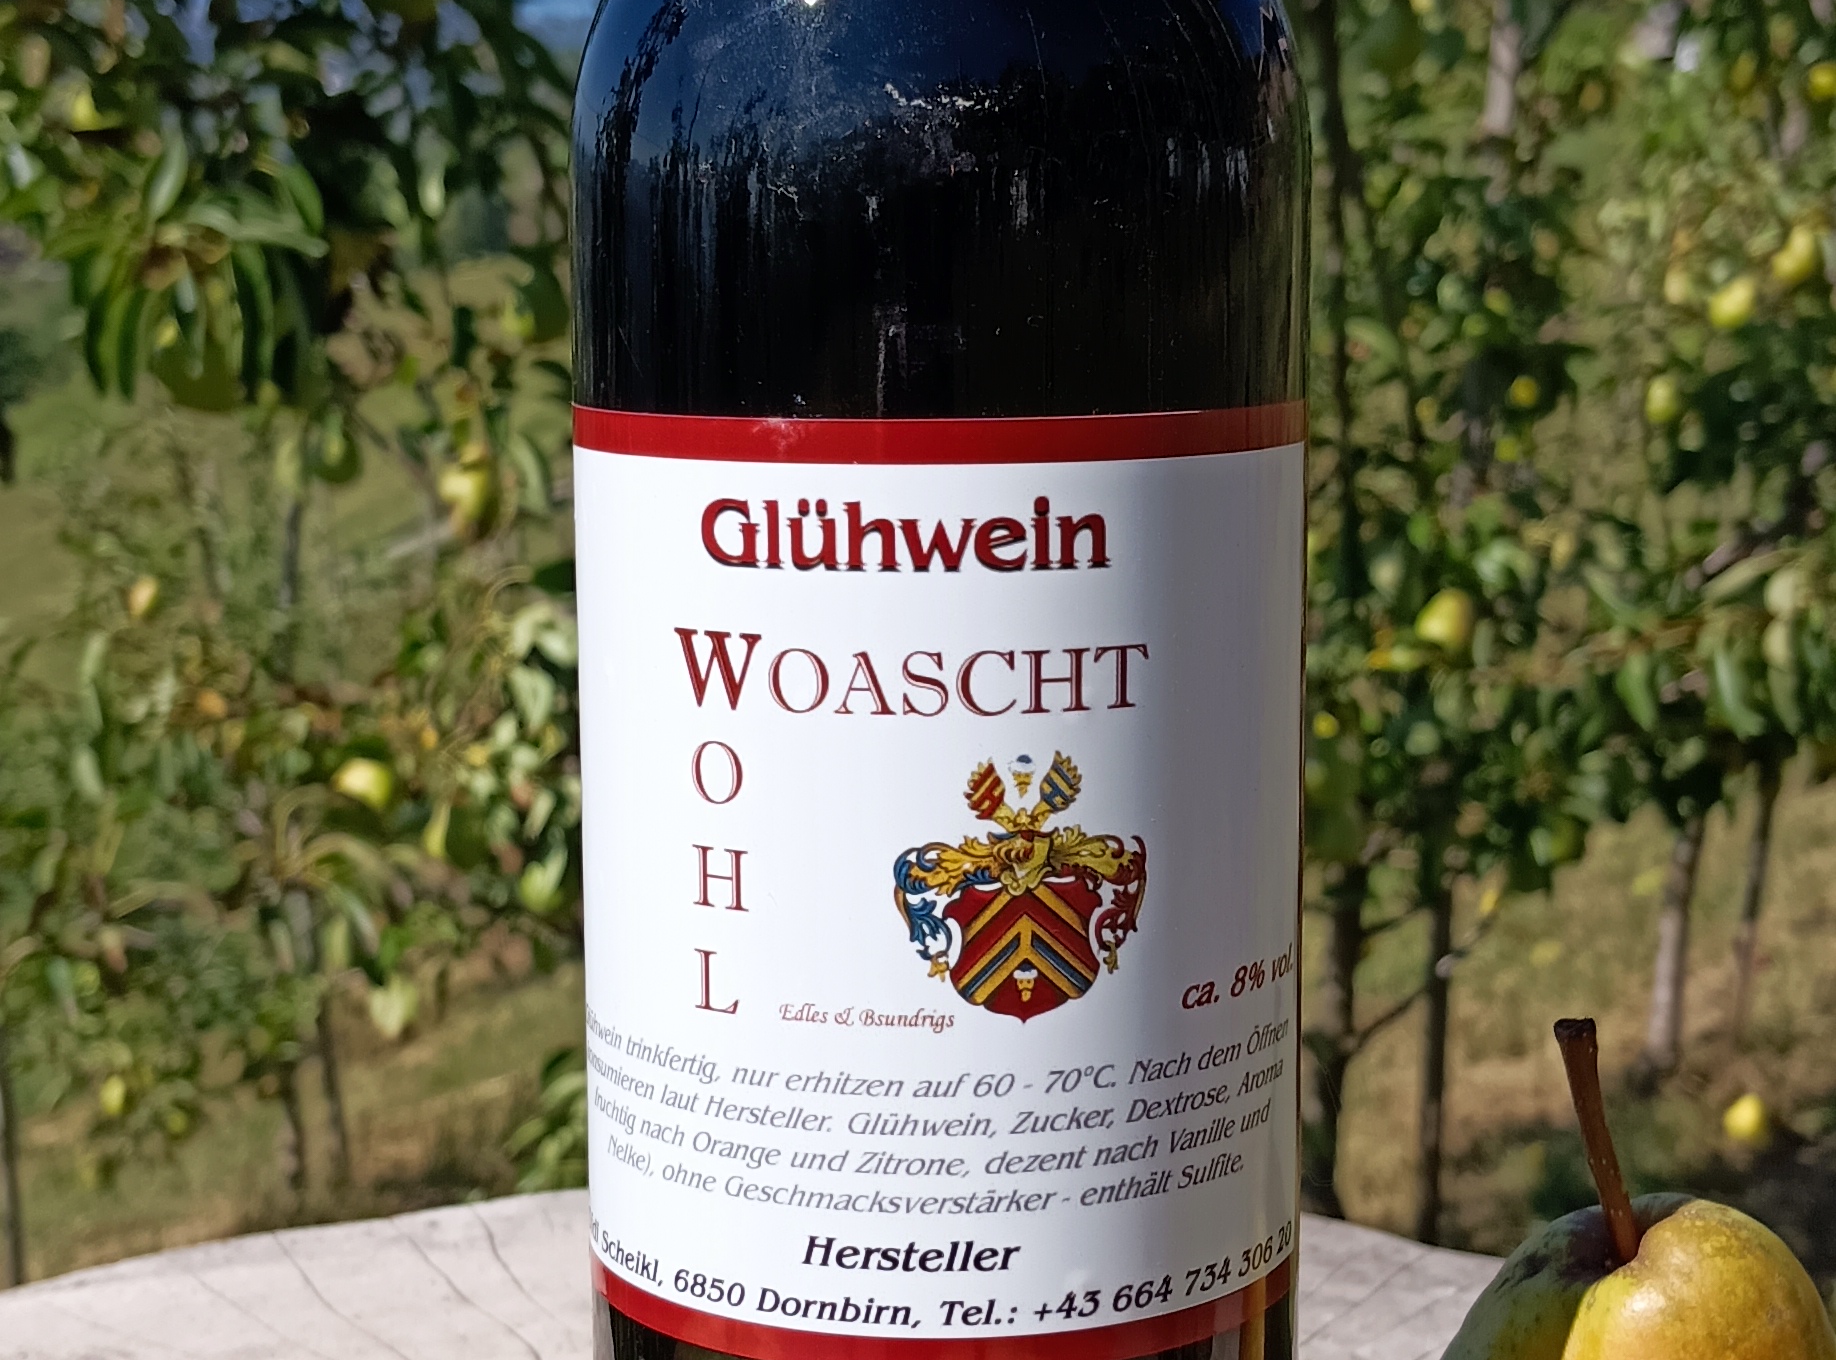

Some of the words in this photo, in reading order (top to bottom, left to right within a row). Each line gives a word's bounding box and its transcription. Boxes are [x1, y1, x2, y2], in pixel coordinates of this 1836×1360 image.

[700, 496, 1112, 572] Glühwein
[674, 627, 1149, 717] WOASCHT
[1182, 981, 1219, 1009] ca.
[1230, 959, 1265, 998] 8%
[1271, 942, 1292, 982] vol.
[779, 1003, 828, 1023] Edles
[834, 1006, 855, 1027] &
[859, 1007, 955, 1033] Bsundrigs
[626, 1035, 720, 1084] trinkfertig,
[731, 1066, 779, 1088] nur
[785, 1071, 904, 1097] erhitzen
[913, 1072, 970, 1098] auf
[973, 1073, 1015, 1098] 60
[1128, 1051, 1192, 1085] Nach
[1198, 1045, 1242, 1071] dem
[1247, 1018, 1289, 1056] Öffnen
[640, 1124, 685, 1147] nach
[692, 1131, 781, 1169] Orange
[790, 1150, 849, 1172] und
[854, 1150, 970, 1178] Zitrone,
[984, 1145, 1087, 1174] dezent
[1093, 1135, 1158, 1167] nach
[1169, 1117, 1236, 1154] Vanille
[1240, 1098, 1271, 1133] und
[660, 1084, 700, 1113] laut
[704, 1095, 832, 1132] Hersteller.
[848, 1112, 996, 1138] Glühwein,
[1008, 1107, 1114, 1135] Zucker,
[1126, 1084, 1230, 1123] Dextrose,
[1237, 1059, 1284, 1097] Aroma
[607, 1134, 654, 1177] Nelke),
[662, 1162, 717, 1192] ohne
[724, 1175, 1057, 1215] Geschmacksverstärker
[1080, 1170, 1173, 1207] enthält
[1177, 1153, 1244, 1190] Sulfite.
[601, 1230, 663, 1287] Scheikl,
[673, 1268, 746, 1307] 6850
[756, 1287, 921, 1329] Dornbirn,
[940, 1298, 1018, 1327] Tel.:
[1033, 1289, 1101, 1322] +43
[1112, 1274, 1173, 1312] 664
[1185, 1255, 1231, 1296] 734
[1238, 1235, 1273, 1277] 306
[1276, 1220, 1292, 1255] 20
[801, 1235, 1021, 1273] Hersteller
